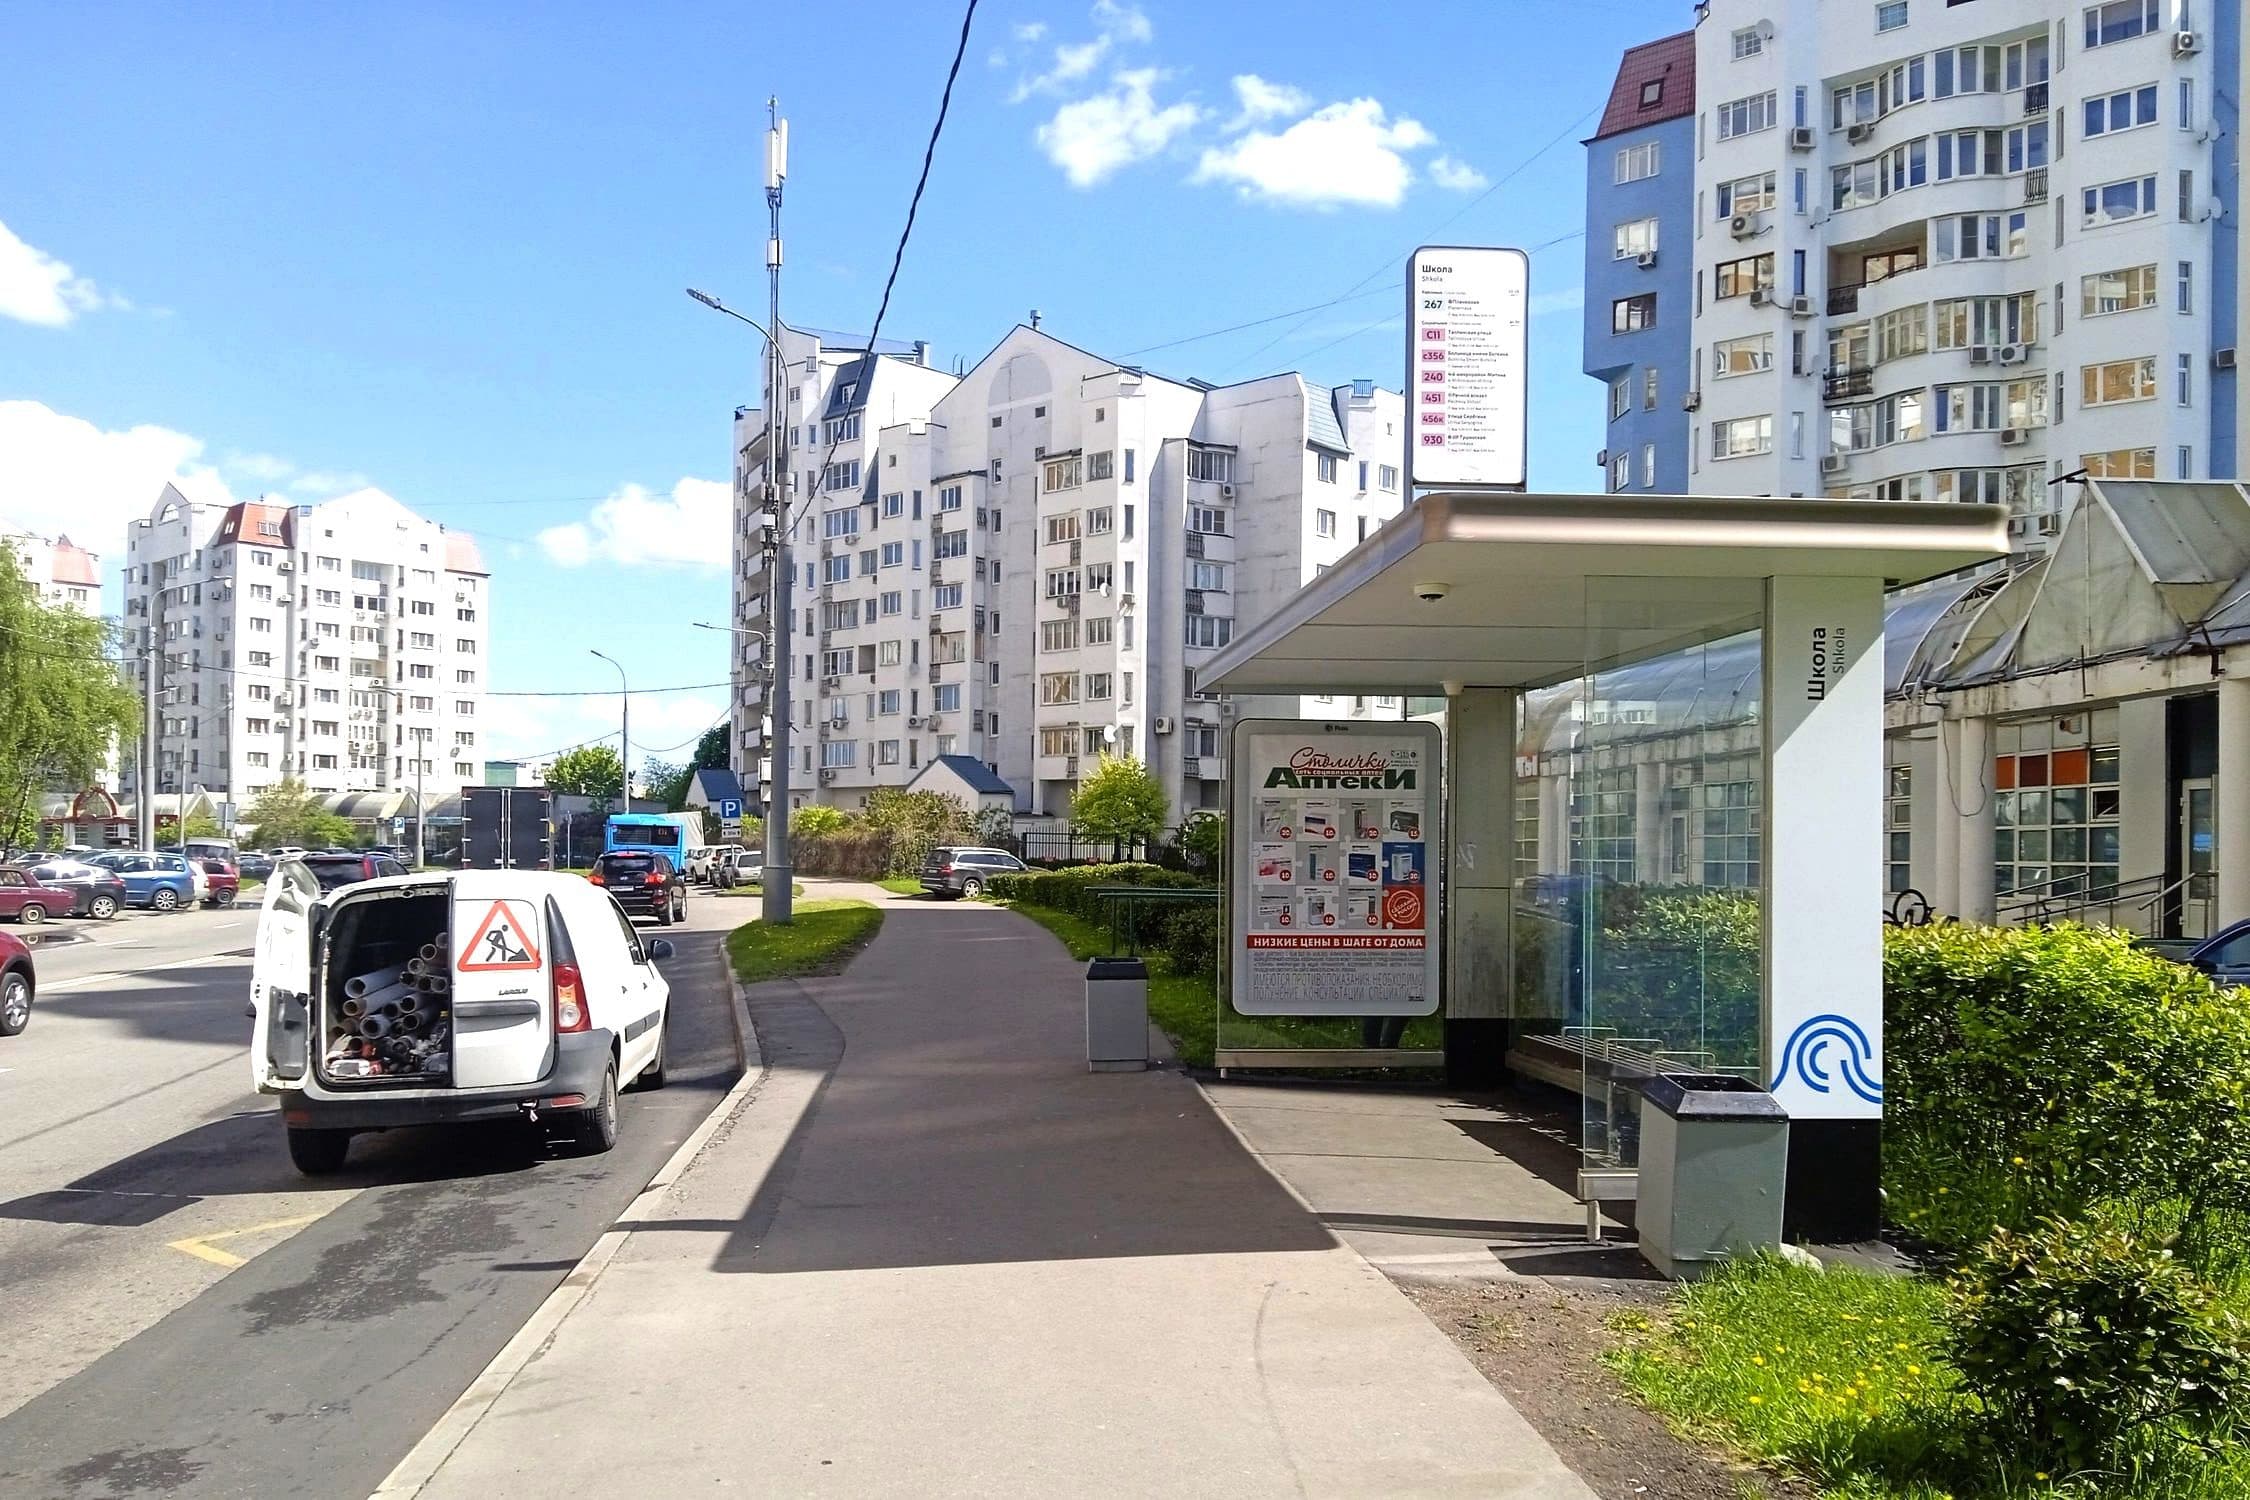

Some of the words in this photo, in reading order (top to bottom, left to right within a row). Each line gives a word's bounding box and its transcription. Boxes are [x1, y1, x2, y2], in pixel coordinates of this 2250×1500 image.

[1422, 264, 1453, 274] Школа
[1421, 275, 1443, 283] Shkola
[1423, 299, 1443, 309] 267
[1423, 372, 1443, 382] 240
[1425, 393, 1441, 403] 451
[1423, 435, 1443, 446] 930
[1832, 627, 1845, 674] Shkola
[1807, 627, 1826, 701] Школа
[1289, 746, 1392, 769] Столички
[1253, 938, 1298, 947] НИЗКИЕ
[1300, 938, 1331, 948] ЦЕНЫ
[1333, 938, 1340, 947] В
[1343, 938, 1372, 947] ШАГЕ
[1374, 938, 1387, 947] ОТ
[1389, 938, 1423, 948] ДОМА
[1253, 973, 1290, 986] ИМЕЮТСЯ
